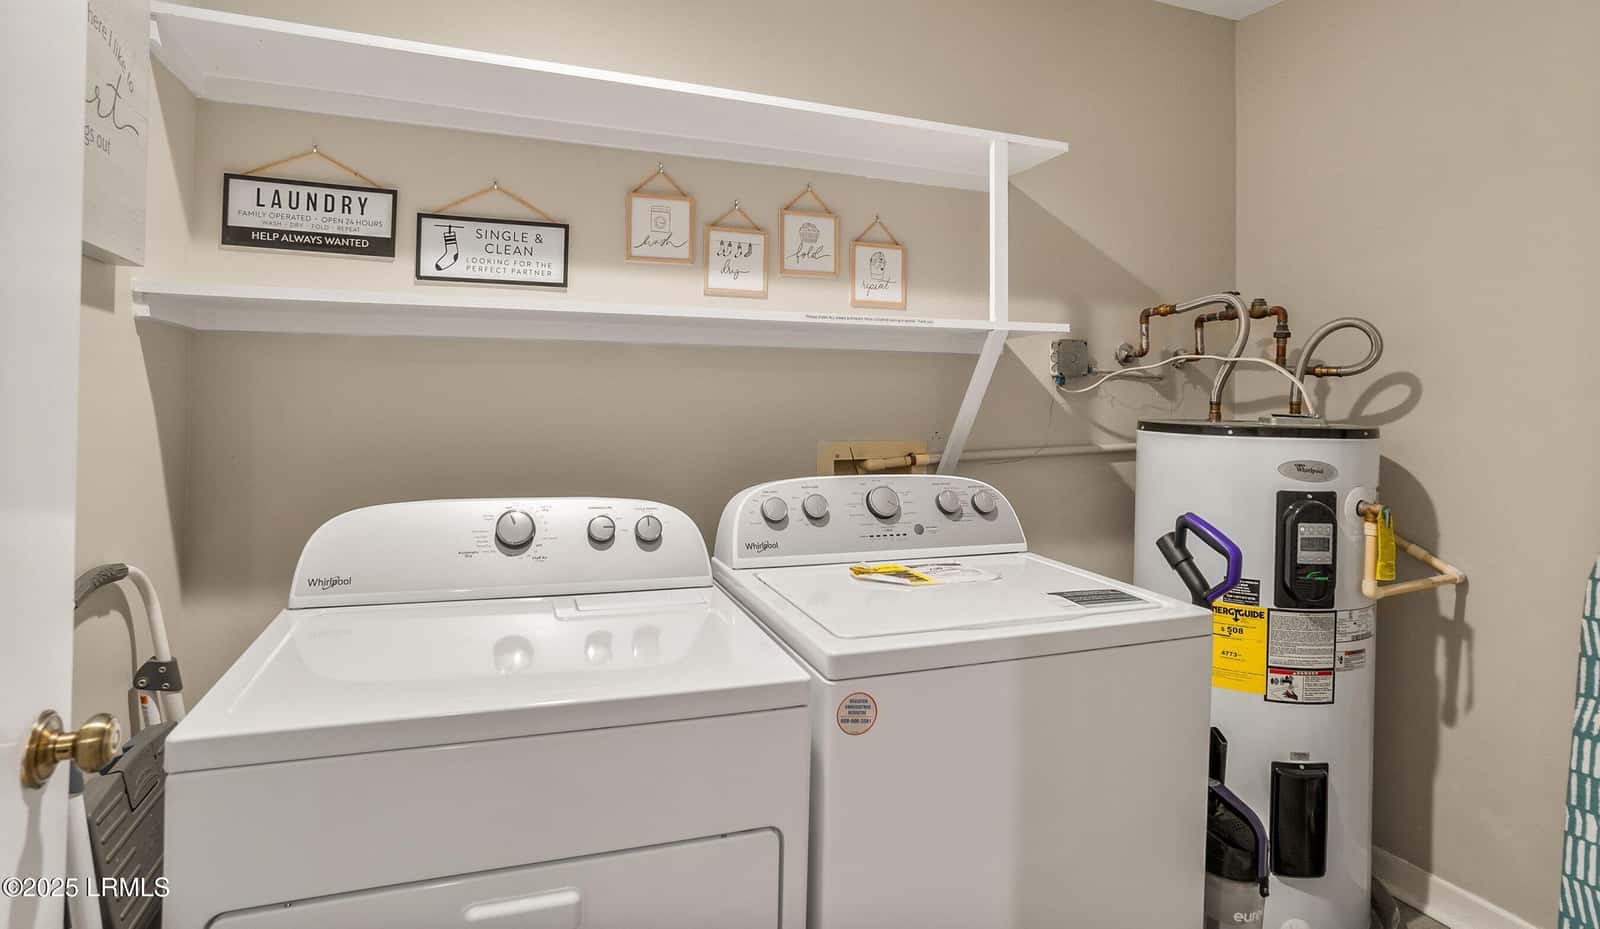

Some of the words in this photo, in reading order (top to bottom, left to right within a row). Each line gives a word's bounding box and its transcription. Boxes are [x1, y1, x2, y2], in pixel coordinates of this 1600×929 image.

[87, 2, 107, 40] here
[113, 39, 127, 73] like
[97, 134, 111, 155] out
[256, 187, 368, 216] LAUNDRY
[238, 210, 267, 218] FAMILY
[268, 212, 312, 222] OPERATED
[320, 216, 344, 224] OPEN
[344, 218, 354, 226] 24
[355, 219, 383, 228] HOURS
[251, 231, 280, 241] HELP
[281, 234, 323, 245] ALWAYS
[323, 236, 370, 248] WANTED
[475, 228, 529, 243] SINGLE
[534, 233, 544, 244] &
[484, 243, 534, 257] CLEAN
[465, 257, 510, 266] LOOKING
[513, 259, 532, 268] FOR
[536, 261, 553, 269] THE
[465, 265, 507, 275] PERFECT
[511, 267, 553, 277] PARTNER
[744, 540, 778, 553] Whirlpool
[307, 576, 352, 591] Whirlpool
